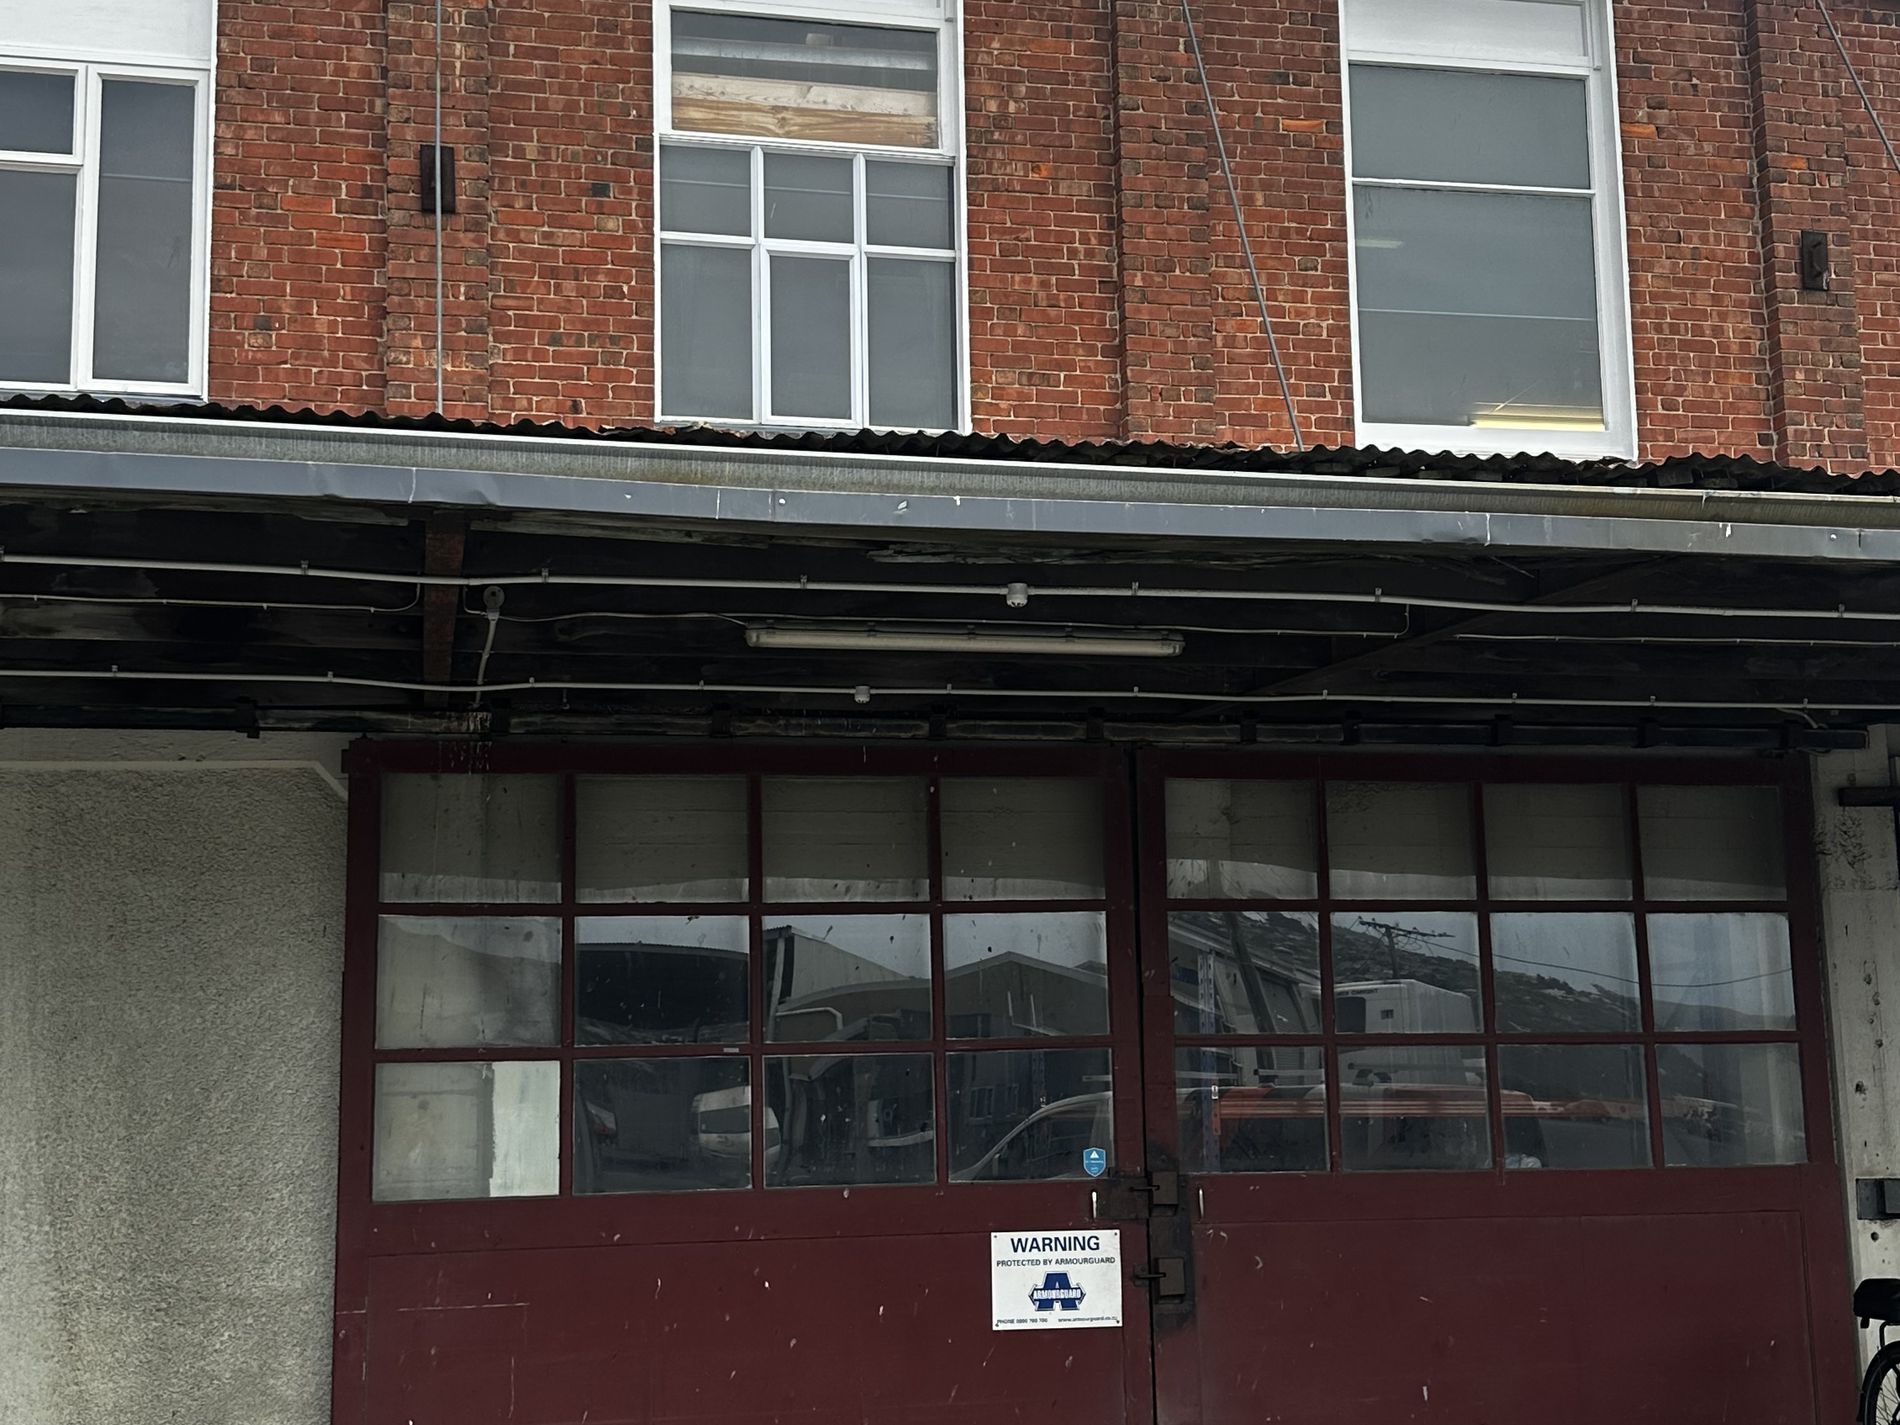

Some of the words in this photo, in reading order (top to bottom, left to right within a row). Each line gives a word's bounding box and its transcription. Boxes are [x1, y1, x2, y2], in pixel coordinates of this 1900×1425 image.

[1010, 1235, 1101, 1253] WARNING
[996, 1259, 1041, 1267] PROTECTED
[1042, 1258, 1053, 1266] BY
[1054, 1256, 1116, 1266] ARMOURGUARD
[1033, 1288, 1082, 1300] ARMOURGUARD
